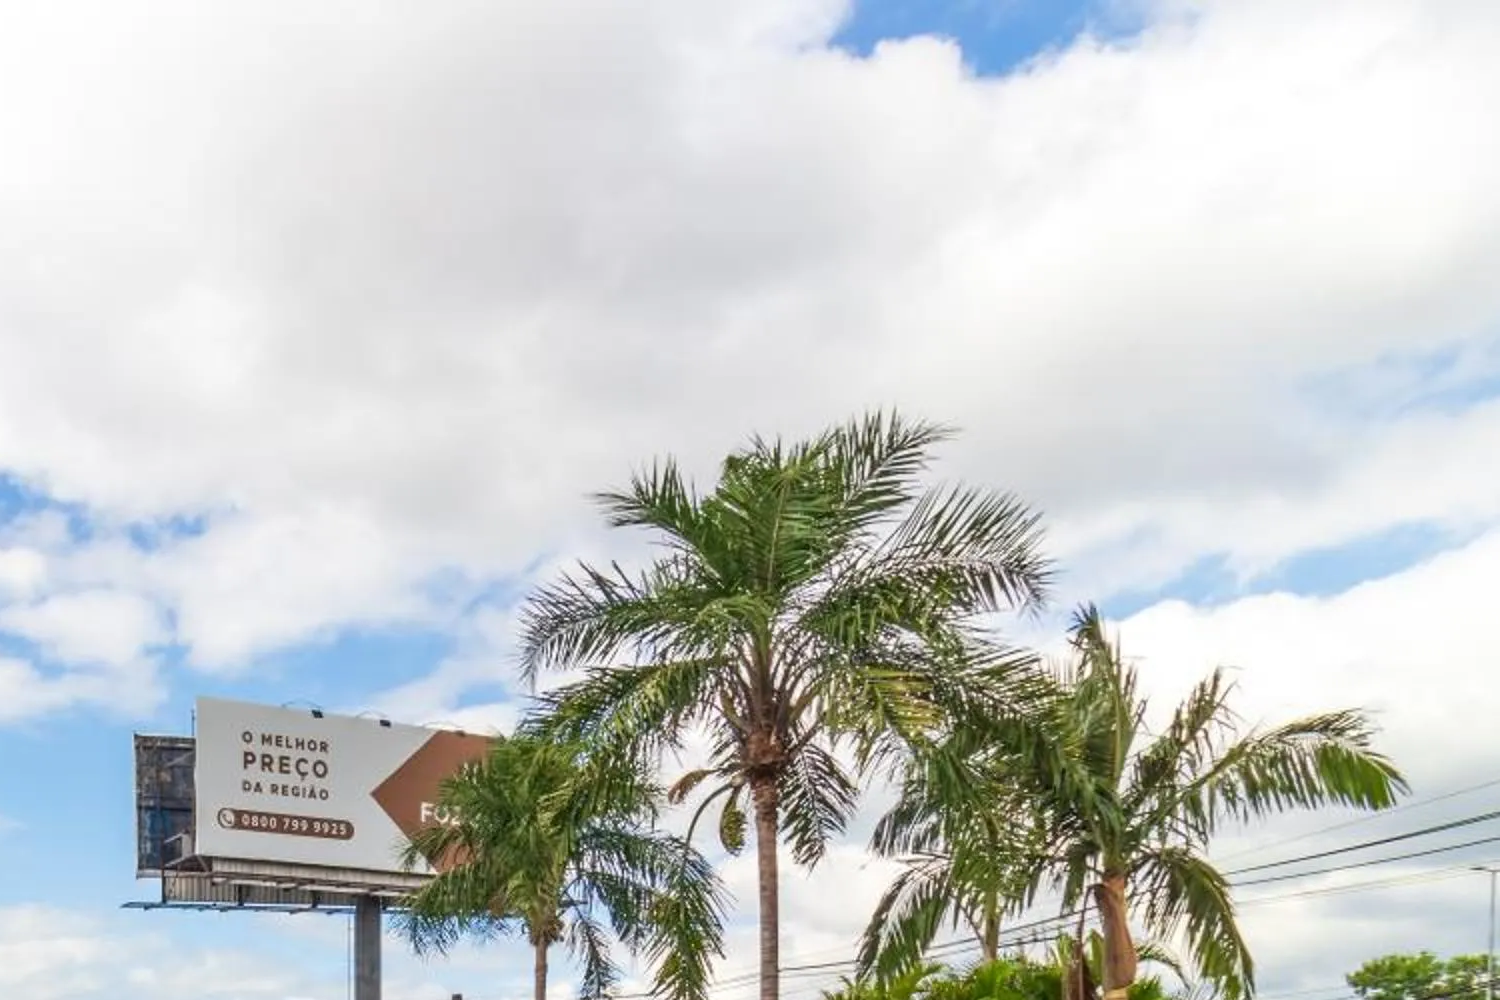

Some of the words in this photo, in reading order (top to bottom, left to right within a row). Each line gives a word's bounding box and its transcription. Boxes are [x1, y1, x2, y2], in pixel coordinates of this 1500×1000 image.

[242, 731, 253, 744] O
[261, 733, 329, 753] MELHOR
[243, 751, 329, 781] PREÇO
[242, 780, 263, 794] DA
[270, 783, 329, 801] REGIÃO
[241, 813, 277, 829] 0800
[283, 817, 309, 832] 799
[313, 821, 347, 836] 9925
